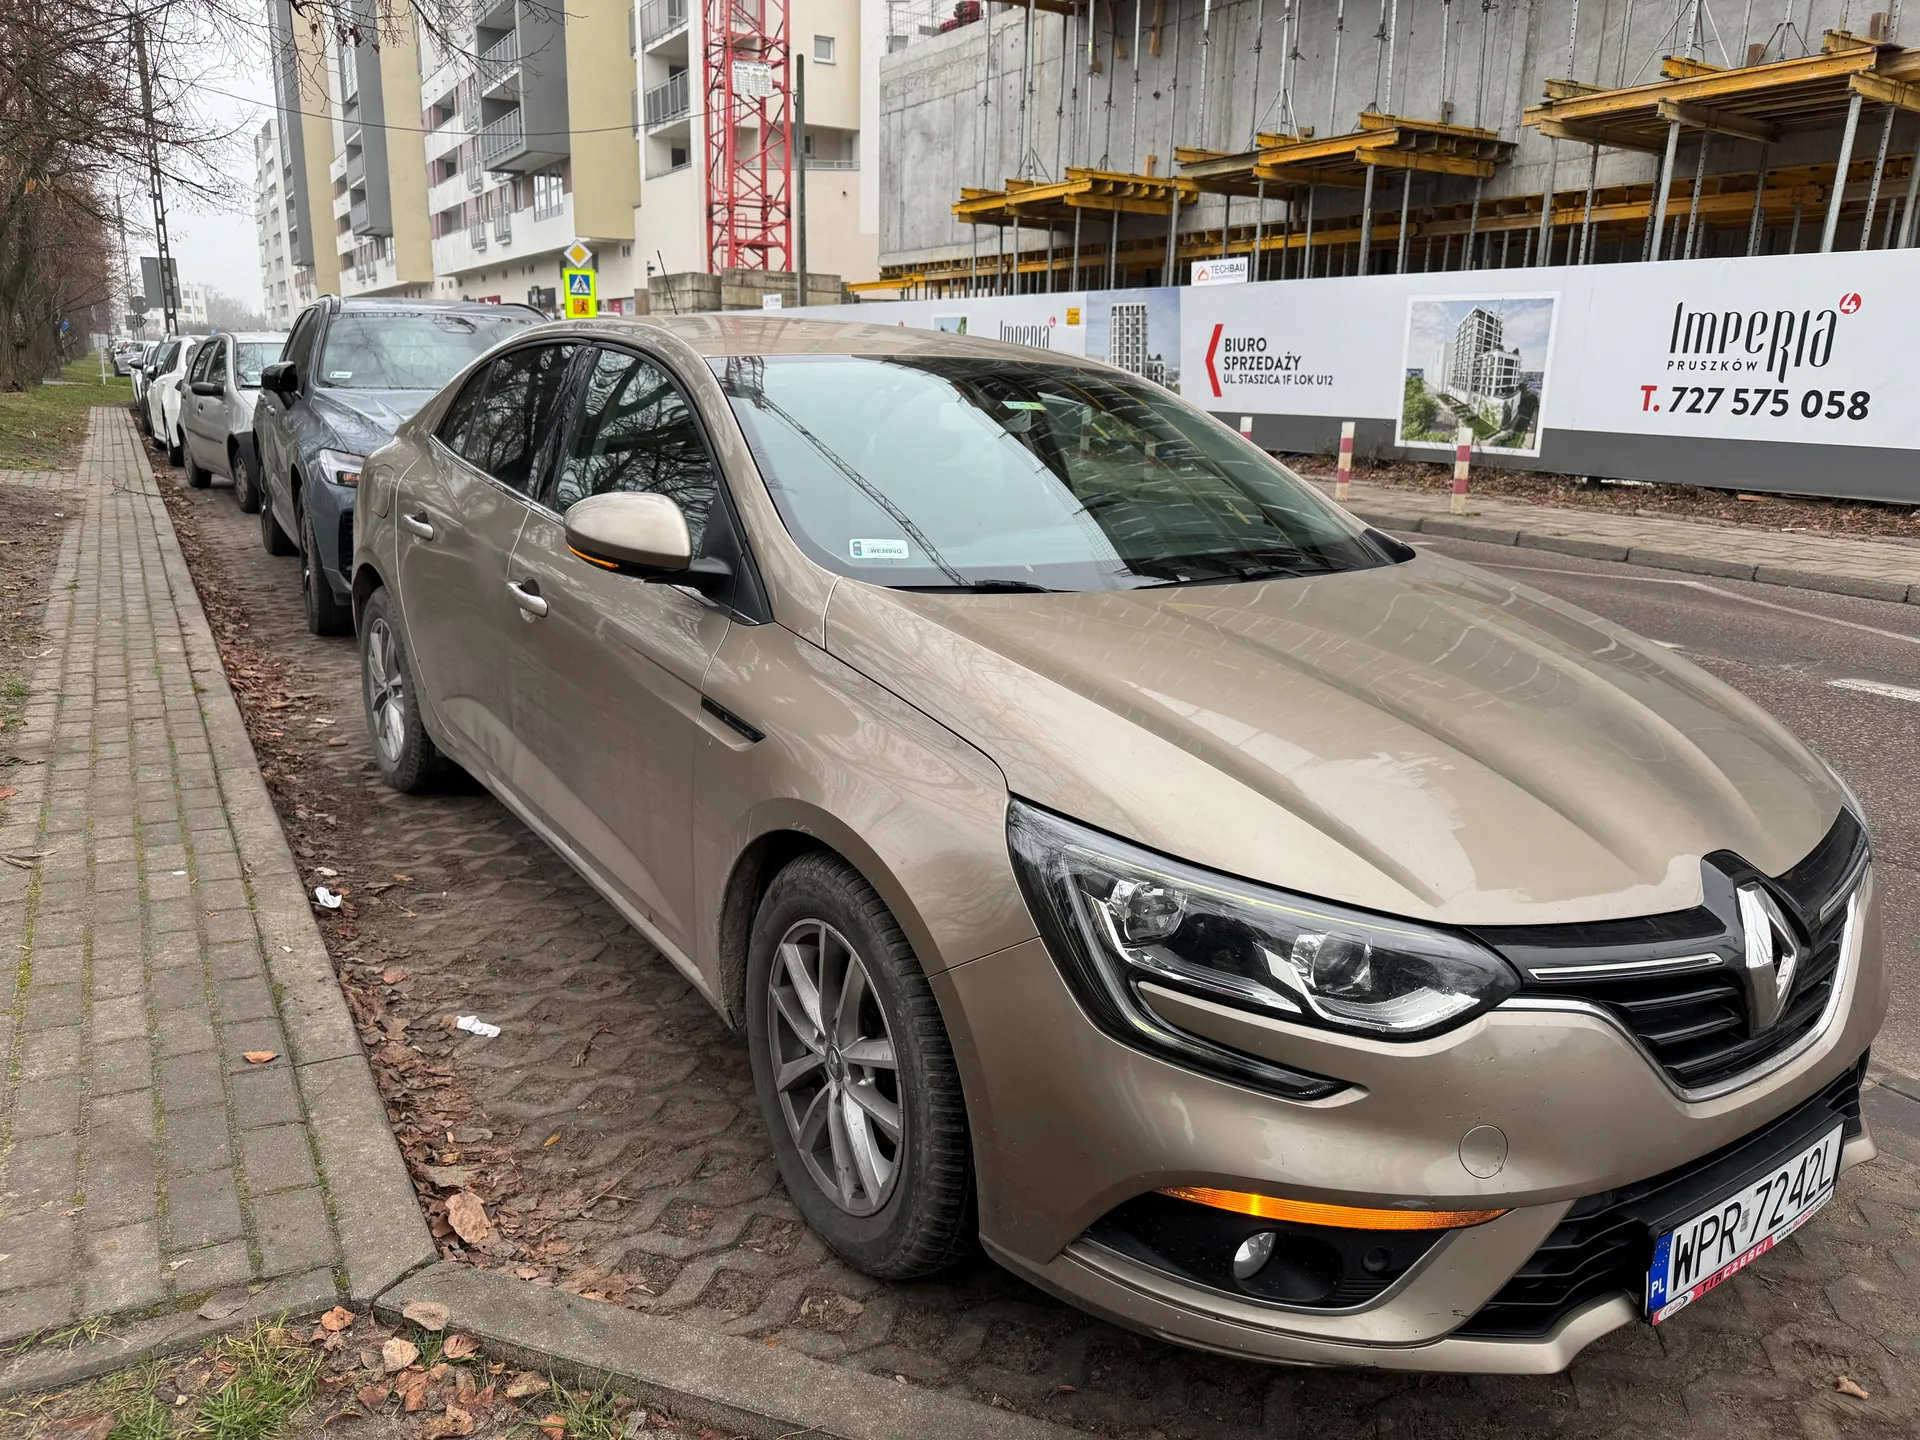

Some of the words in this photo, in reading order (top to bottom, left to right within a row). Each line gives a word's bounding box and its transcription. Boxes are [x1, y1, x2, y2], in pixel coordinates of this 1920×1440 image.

[1210, 263, 1245, 275] TECHBAU
[1225, 338, 1267, 352] BIURO
[1224, 351, 1301, 371] SPRZEDAŻY
[1667, 358, 1758, 371] PRUSZKÓW
[1224, 374, 1237, 384] UL.
[1238, 374, 1280, 385] STASZICA
[1282, 375, 1292, 385] 1F
[1294, 375, 1314, 385] LOK
[1316, 375, 1333, 386] U12
[1640, 385, 1660, 412] T.
[1668, 386, 1725, 414] 727
[1731, 388, 1789, 417] 575
[1800, 390, 1871, 420] 058
[1651, 1280, 1665, 1298] PL
[1672, 1201, 1742, 1292] WPR
[1749, 1138, 1831, 1244] 7242L
